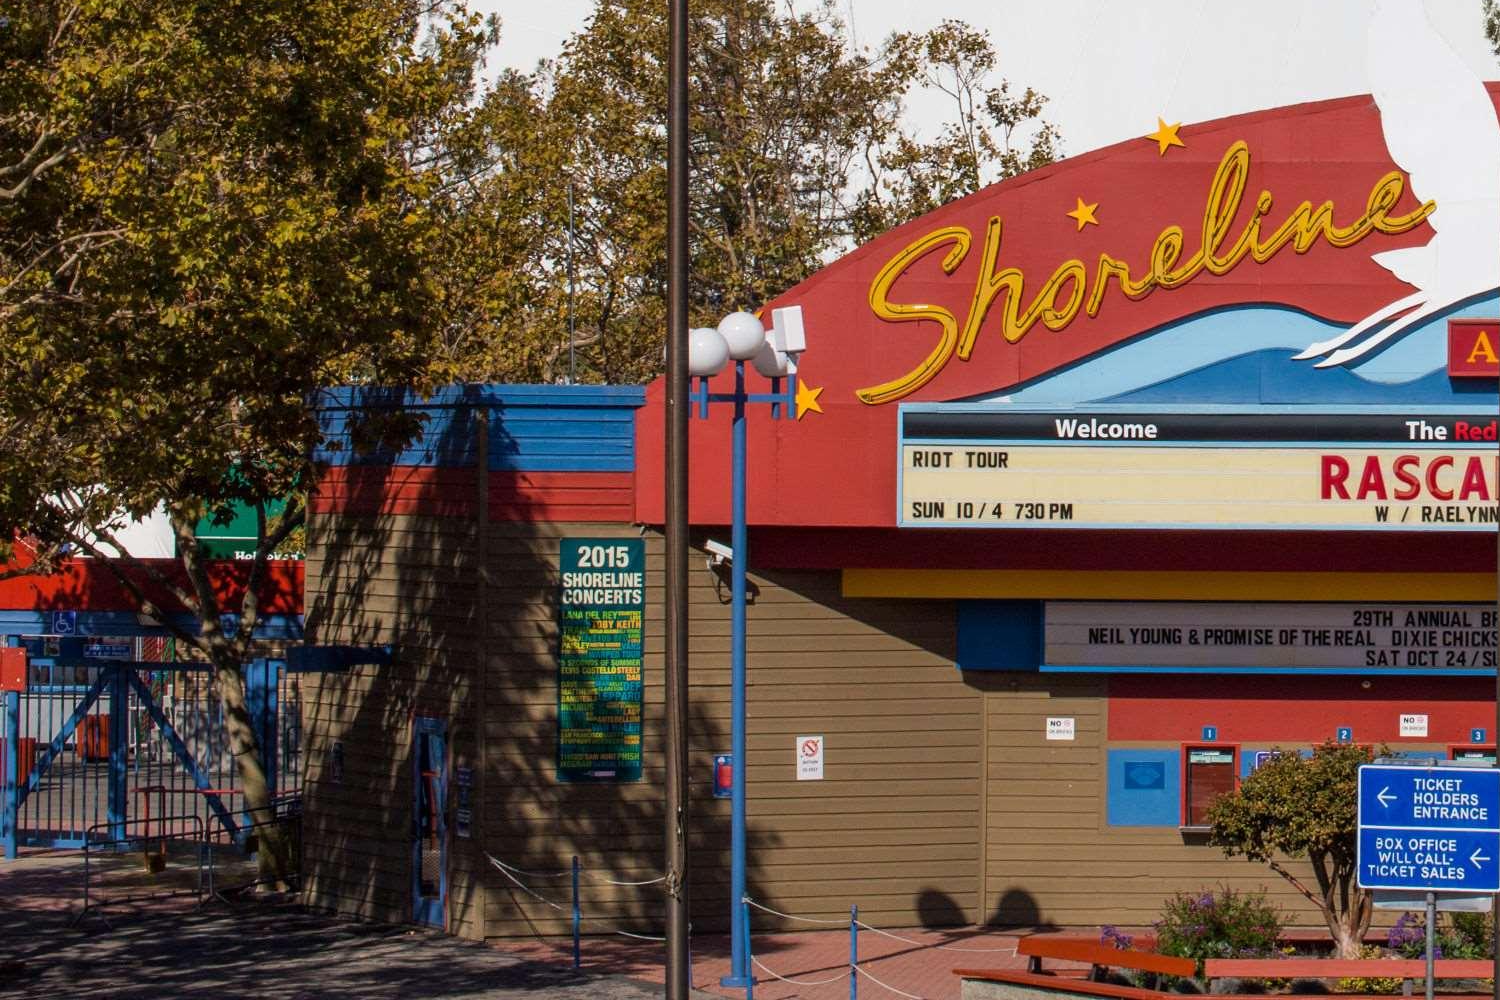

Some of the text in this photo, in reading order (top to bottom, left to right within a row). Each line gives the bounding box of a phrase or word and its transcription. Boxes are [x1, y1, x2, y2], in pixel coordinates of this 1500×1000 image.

[856, 139, 1436, 404] Shoreline
[1055, 418, 1158, 439] Welcome
[1405, 420, 1447, 440] The
[912, 452, 1009, 469] RIOT TOUR
[912, 502, 945, 519] SUN
[1421, 505, 1500, 523] RAELYNN
[577, 545, 630, 568] 2015
[562, 572, 643, 588] SHORELINE
[562, 589, 642, 605] CONCERTS
[1353, 610, 1393, 627] 29TH
[1404, 610, 1472, 627] ANNUAL
[1089, 628, 1125, 645] NEIL
[1130, 628, 1182, 645] YOUNG
[1188, 629, 1200, 645] &
[1204, 628, 1273, 646] PROMISE
[1279, 629, 1298, 646] OF
[1302, 630, 1331, 646] THE
[1334, 630, 1376, 646] REAL
[1392, 631, 1438, 647] DIXIE
[1442, 631, 1498, 647] CHICKS
[1366, 650, 1400, 667] SAT
[1407, 651, 1438, 667] OCT
[1414, 778, 1463, 791] TICKET
[1413, 793, 1479, 806] HOLDERS
[1413, 806, 1488, 820] ENTRANCE
[1376, 838, 1457, 851] BOX OFFICE
[1379, 852, 1411, 864] WILL
[1368, 865, 1465, 880] TICKET SALES
